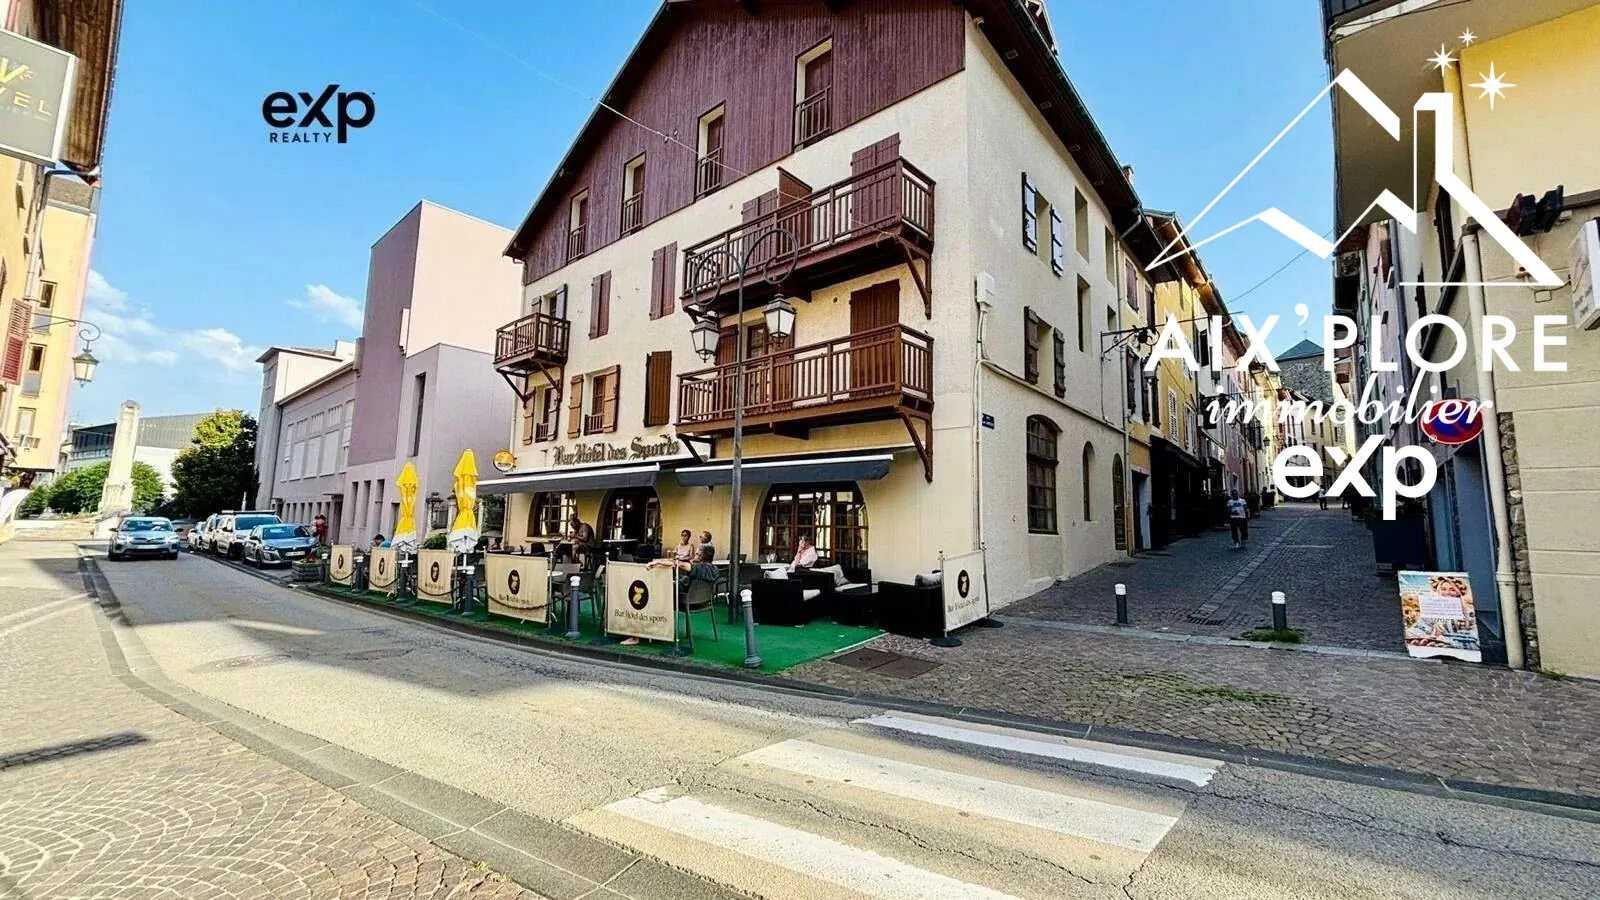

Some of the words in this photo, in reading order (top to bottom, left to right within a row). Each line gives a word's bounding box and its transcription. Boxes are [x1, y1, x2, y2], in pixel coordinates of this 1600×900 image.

[552, 446, 575, 467] Bar
[607, 443, 627, 460] des
[628, 433, 681, 461] Sports
[639, 612, 649, 621] des
[649, 615, 668, 624] sports
